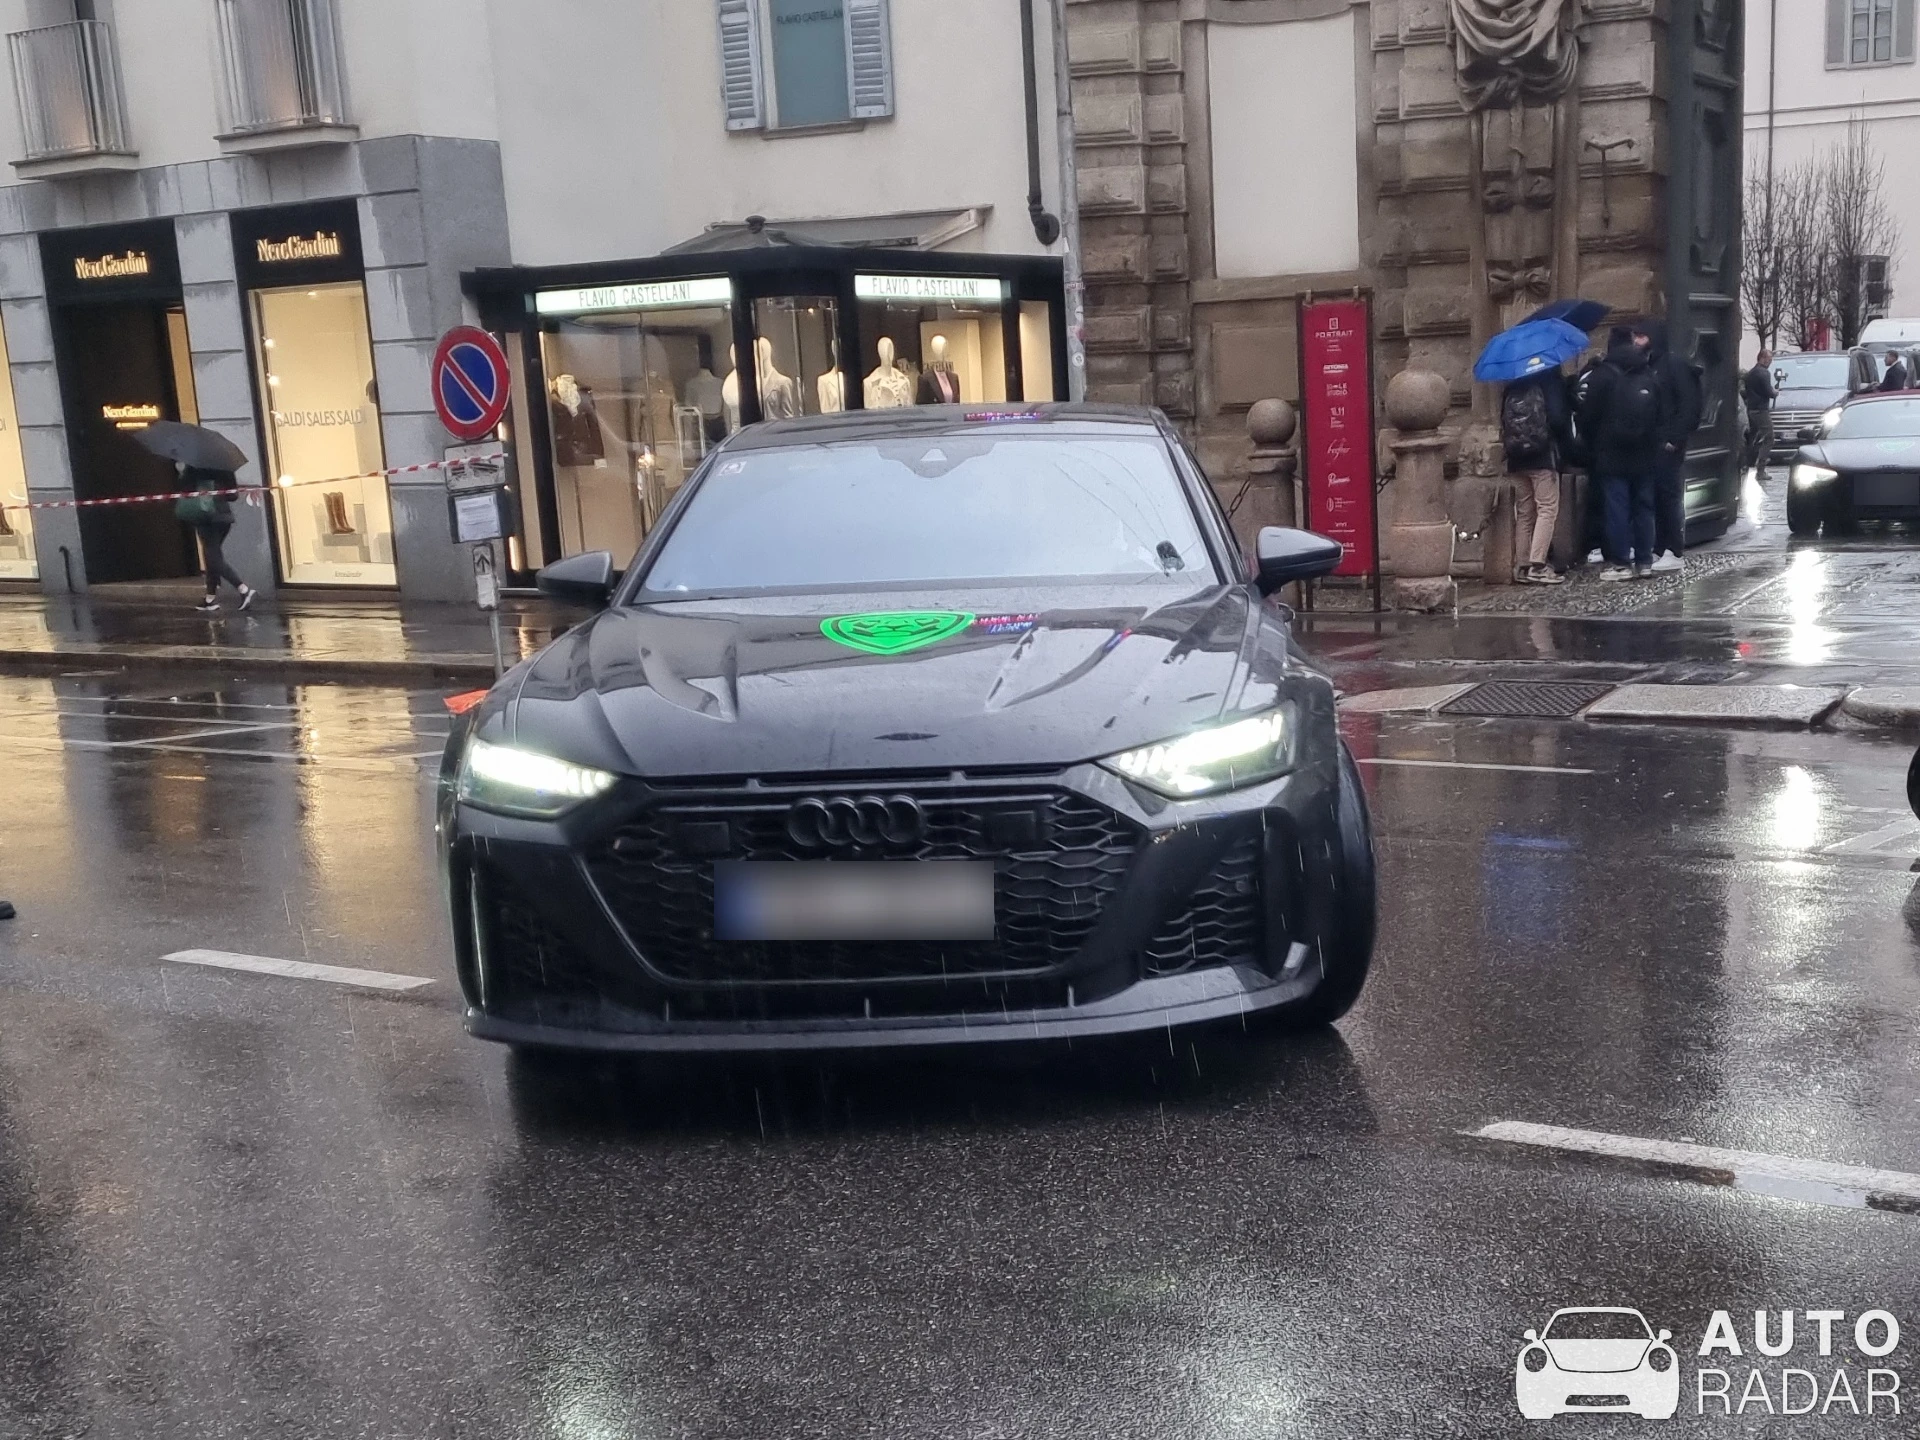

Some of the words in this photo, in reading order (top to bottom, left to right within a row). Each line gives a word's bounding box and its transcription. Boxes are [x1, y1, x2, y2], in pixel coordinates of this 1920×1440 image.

[579, 288, 617, 307] FLAVIO
[622, 283, 691, 305] CASTELLANI
[872, 277, 910, 295] FLAVIO
[916, 279, 979, 297] CASTELLANI
[1315, 329, 1353, 338] PORTRAIT
[307, 411, 336, 427] SALES
